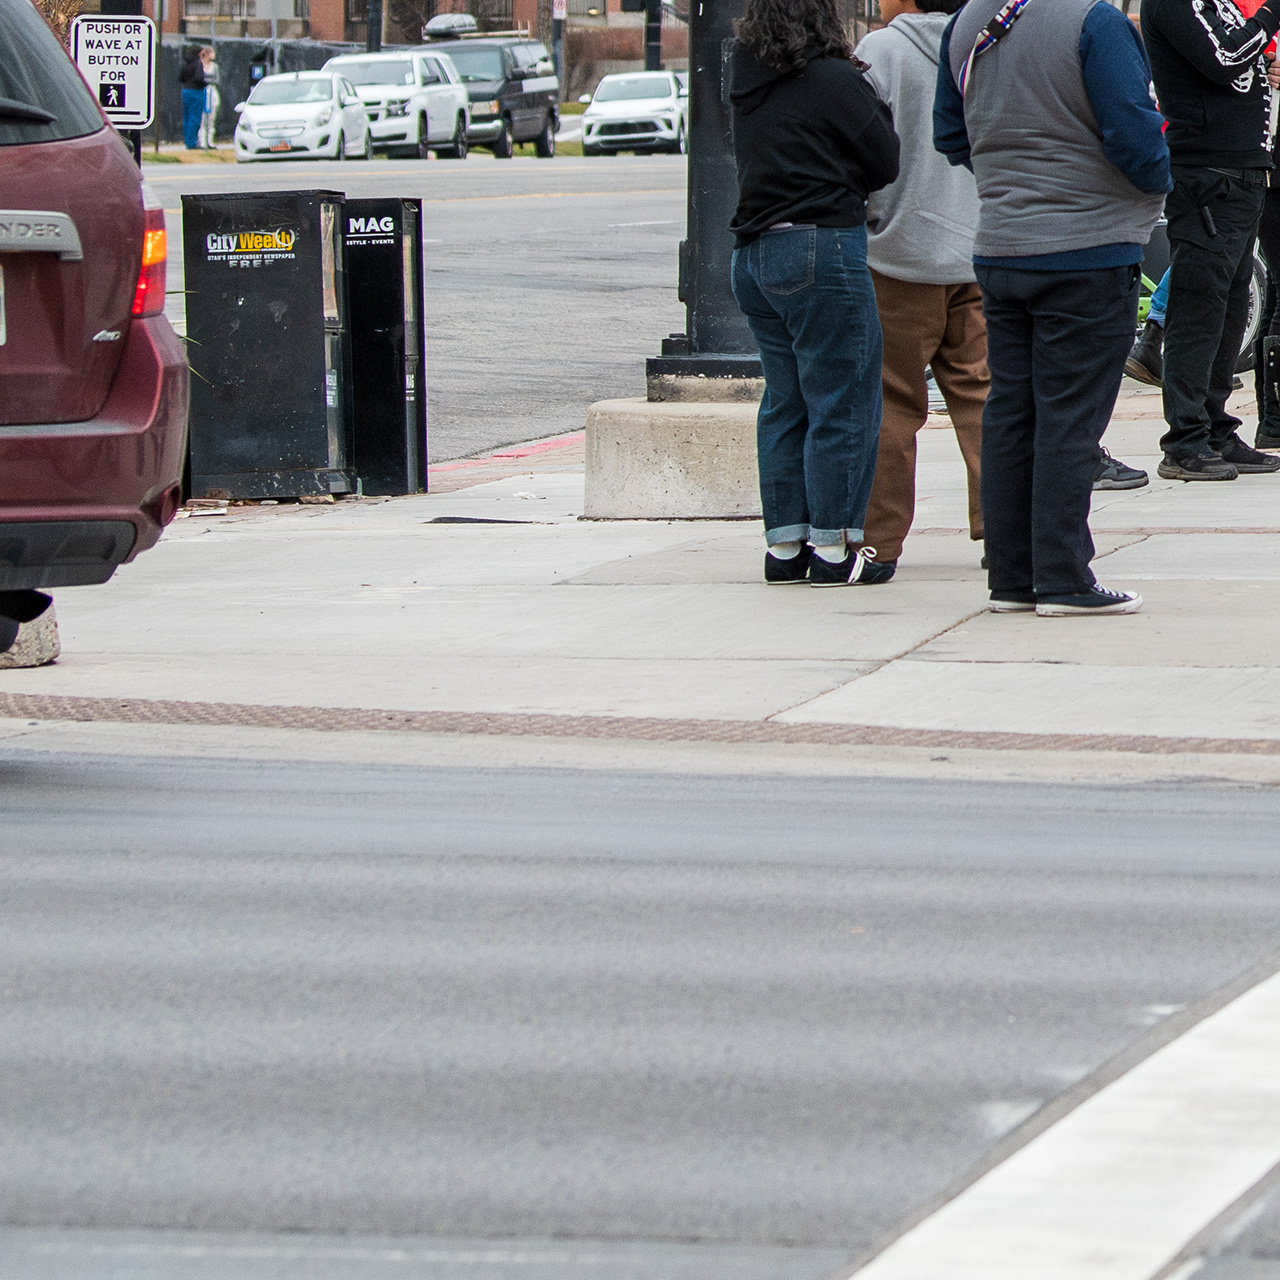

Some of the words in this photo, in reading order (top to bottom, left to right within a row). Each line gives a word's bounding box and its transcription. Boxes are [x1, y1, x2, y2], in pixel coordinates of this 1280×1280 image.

[86, 24, 120, 34] PUSH
[124, 24, 141, 34] OR
[85, 39, 121, 49] WAVE
[125, 40, 142, 49] AT
[88, 55, 138, 65] BUTTON
[100, 71, 126, 81] FOR
[349, 216, 394, 233] MAG
[207, 232, 237, 252] City
[240, 231, 294, 251] Weekly
